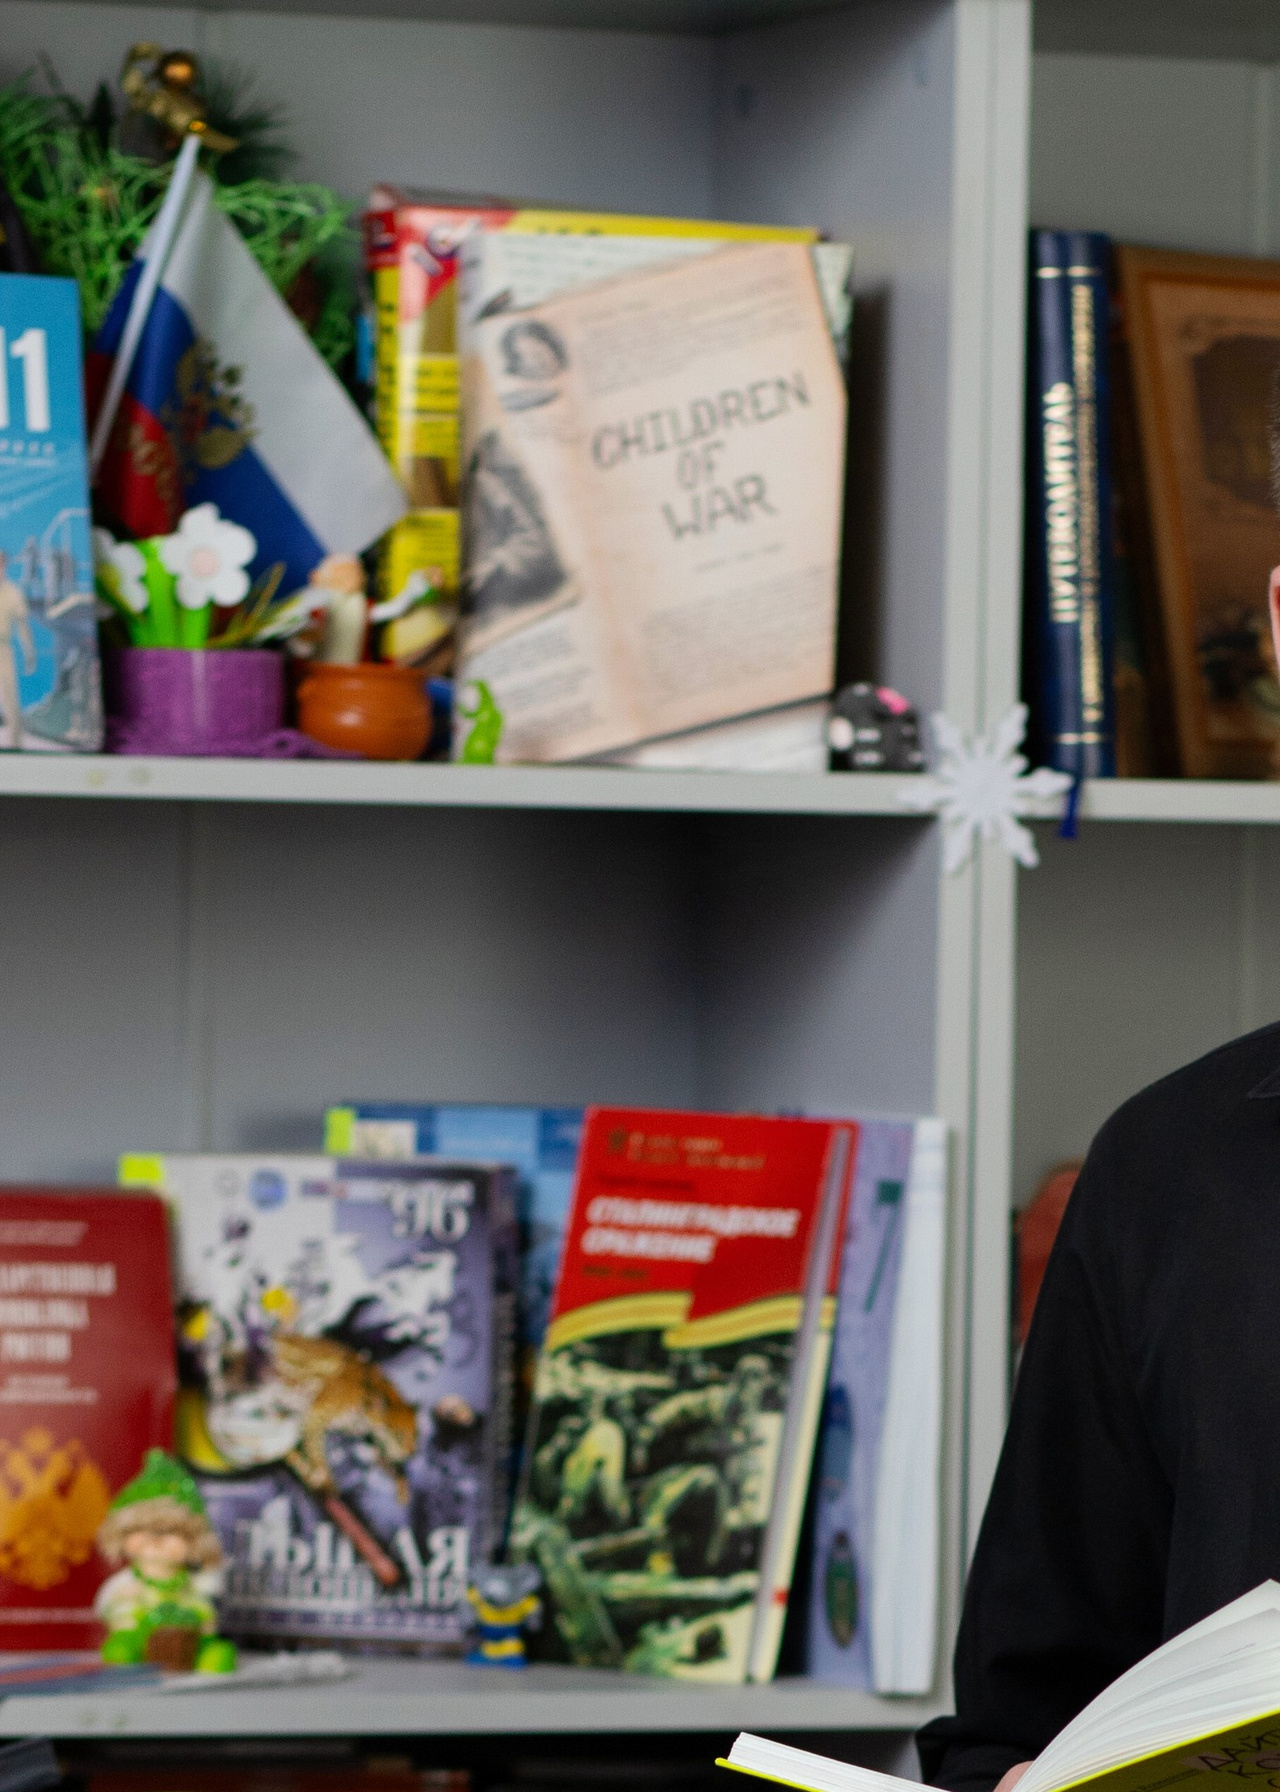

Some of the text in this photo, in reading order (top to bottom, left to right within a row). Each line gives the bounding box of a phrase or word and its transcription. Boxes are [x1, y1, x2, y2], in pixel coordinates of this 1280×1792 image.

[592, 371, 811, 469] CHILDREN
[677, 439, 724, 490] OF
[661, 474, 776, 540] WAR
